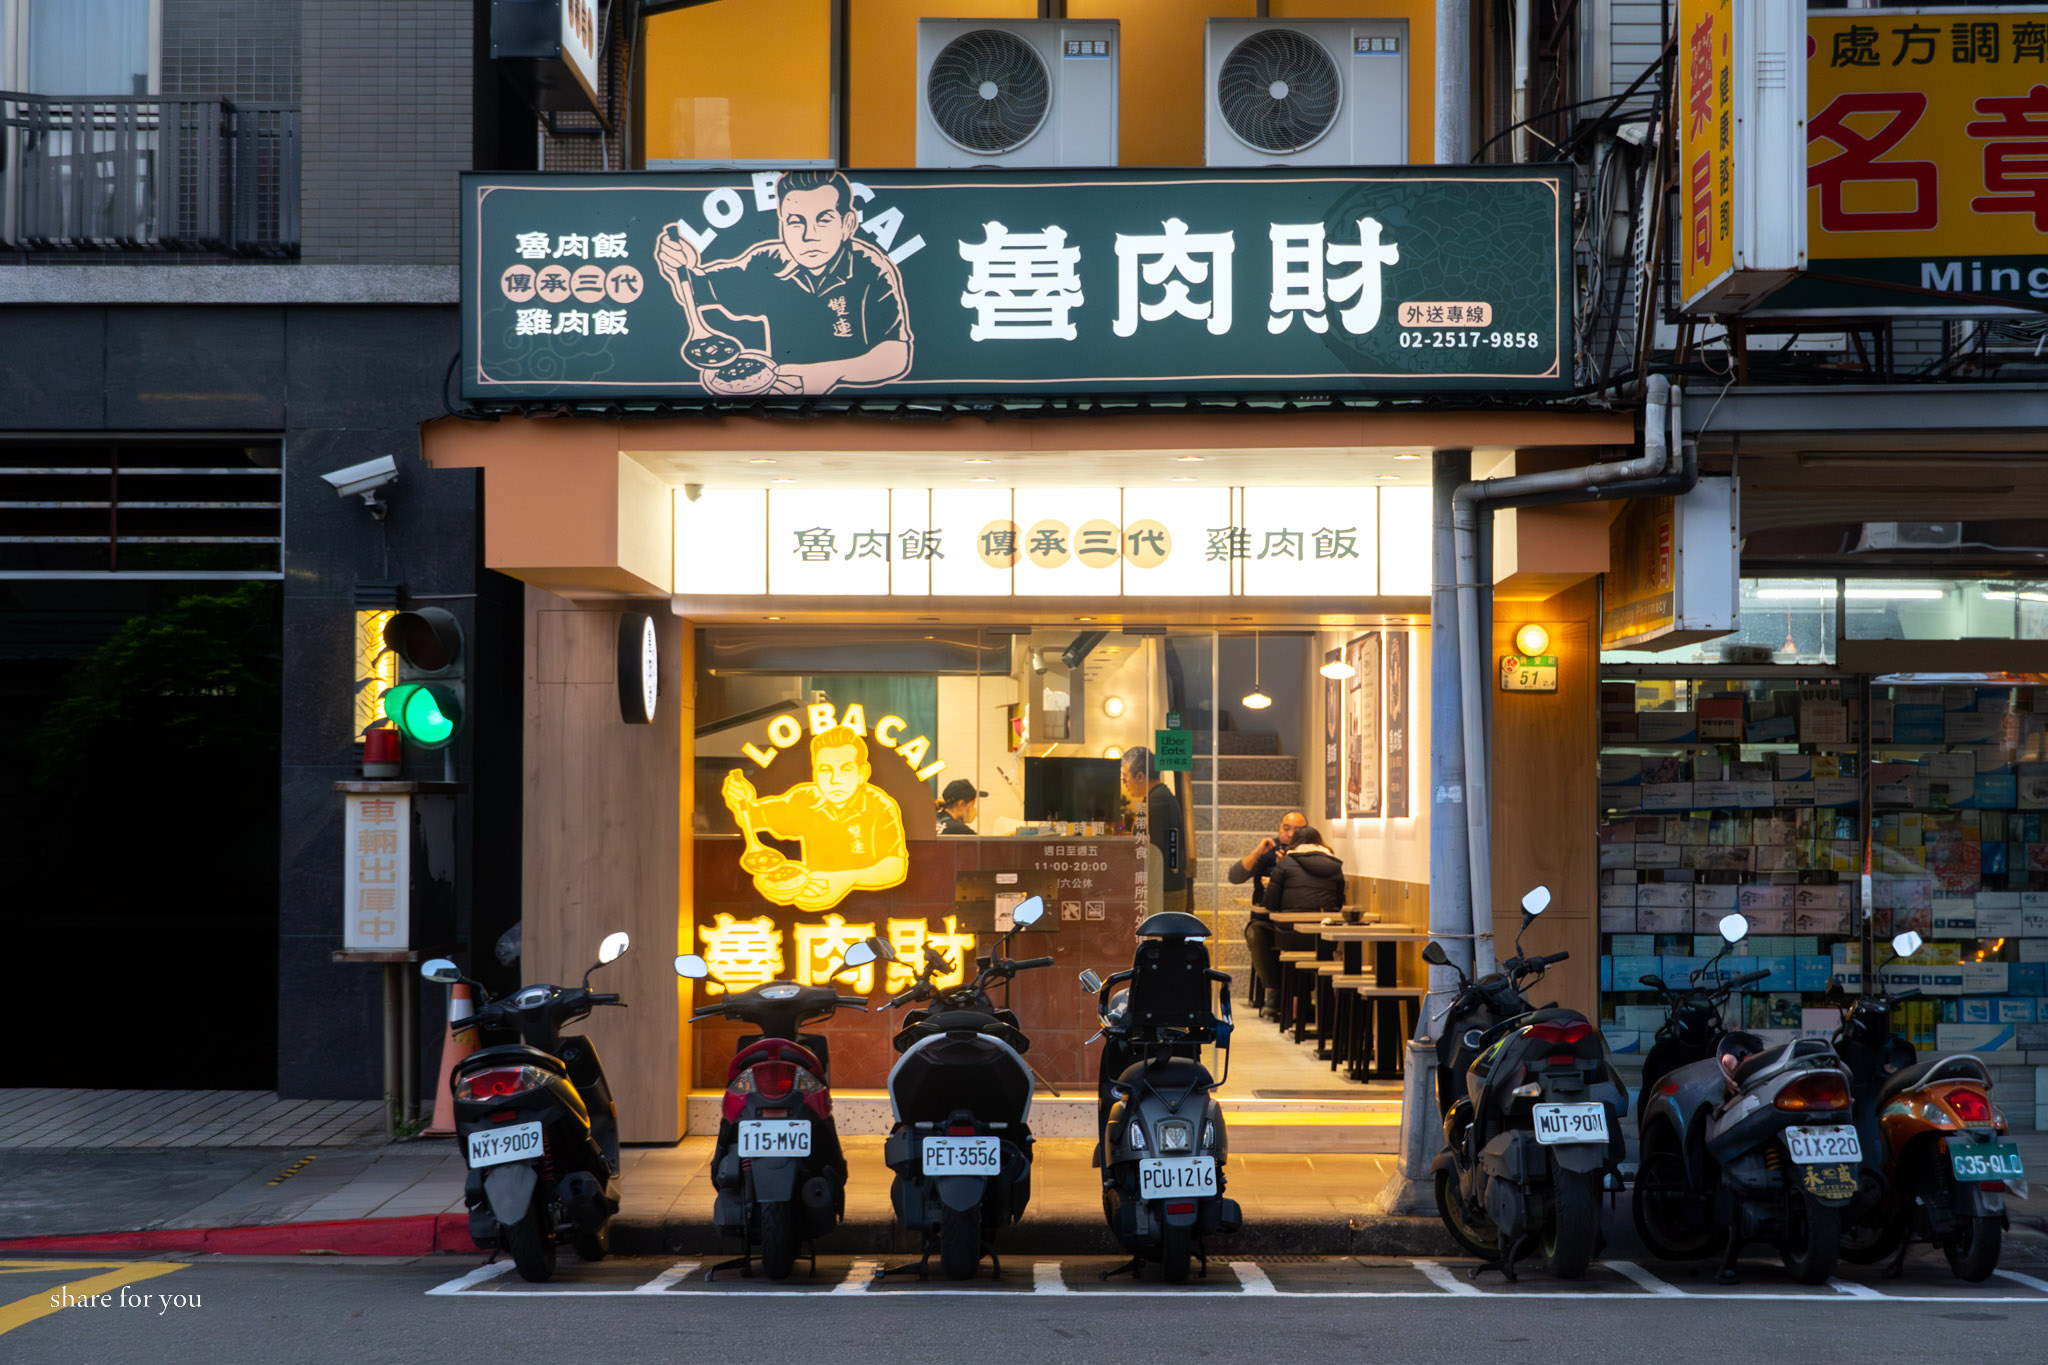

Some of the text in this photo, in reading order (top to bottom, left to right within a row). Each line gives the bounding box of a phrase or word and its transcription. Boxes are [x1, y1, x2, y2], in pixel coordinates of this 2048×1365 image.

[1690, 10, 1714, 281] 藥局
[678, 171, 927, 264] LOBCAI
[515, 232, 629, 259] 魯肉飯
[503, 270, 641, 297] 傳承三代
[959, 217, 1399, 342] 魯肉財
[515, 308, 629, 335] 雞肉飯
[1406, 304, 1485, 325] 外送專線
[1400, 331, 1539, 350] 02-2517-9858
[793, 526, 1360, 562] 魯肉飯 傳承三代 雞肉飯
[1519, 670, 1539, 686] 51
[741, 703, 947, 782] LOBACAI
[1161, 736, 1186, 746] Uber
[1161, 746, 1186, 756] Eats
[358, 799, 399, 942] 車輛出庫中
[1057, 878, 1093, 889] 六公休
